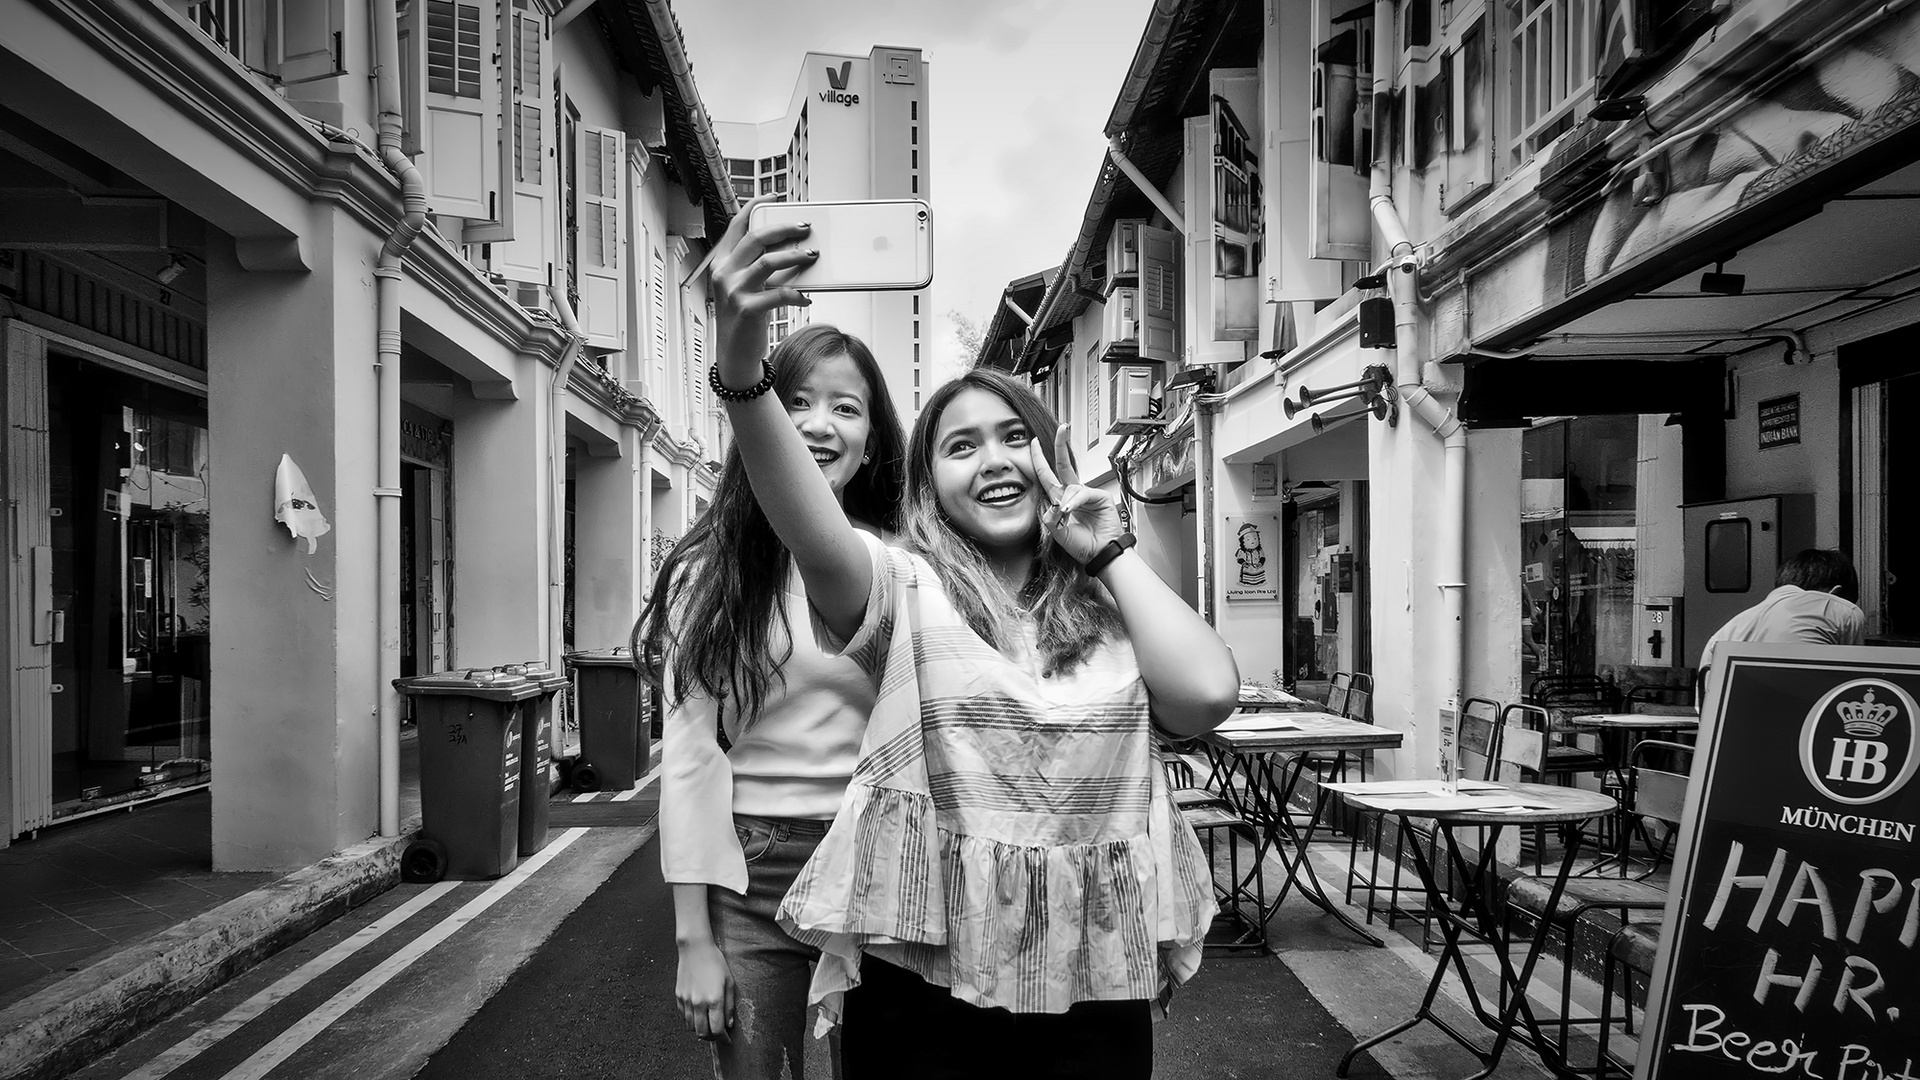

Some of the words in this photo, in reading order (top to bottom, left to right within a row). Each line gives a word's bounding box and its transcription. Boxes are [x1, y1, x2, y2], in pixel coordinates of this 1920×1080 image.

[819, 90, 859, 107] village
[160, 289, 171, 306] 27
[1760, 430, 1781, 444] INDIAN
[1781, 425, 1798, 440] BANK
[1652, 612, 1664, 624] 28
[1826, 737, 1889, 785] HB
[1780, 806, 1916, 843] MÜNCHEN
[1753, 948, 1901, 1024] HR.
[1671, 1003, 1824, 1080] Beer
